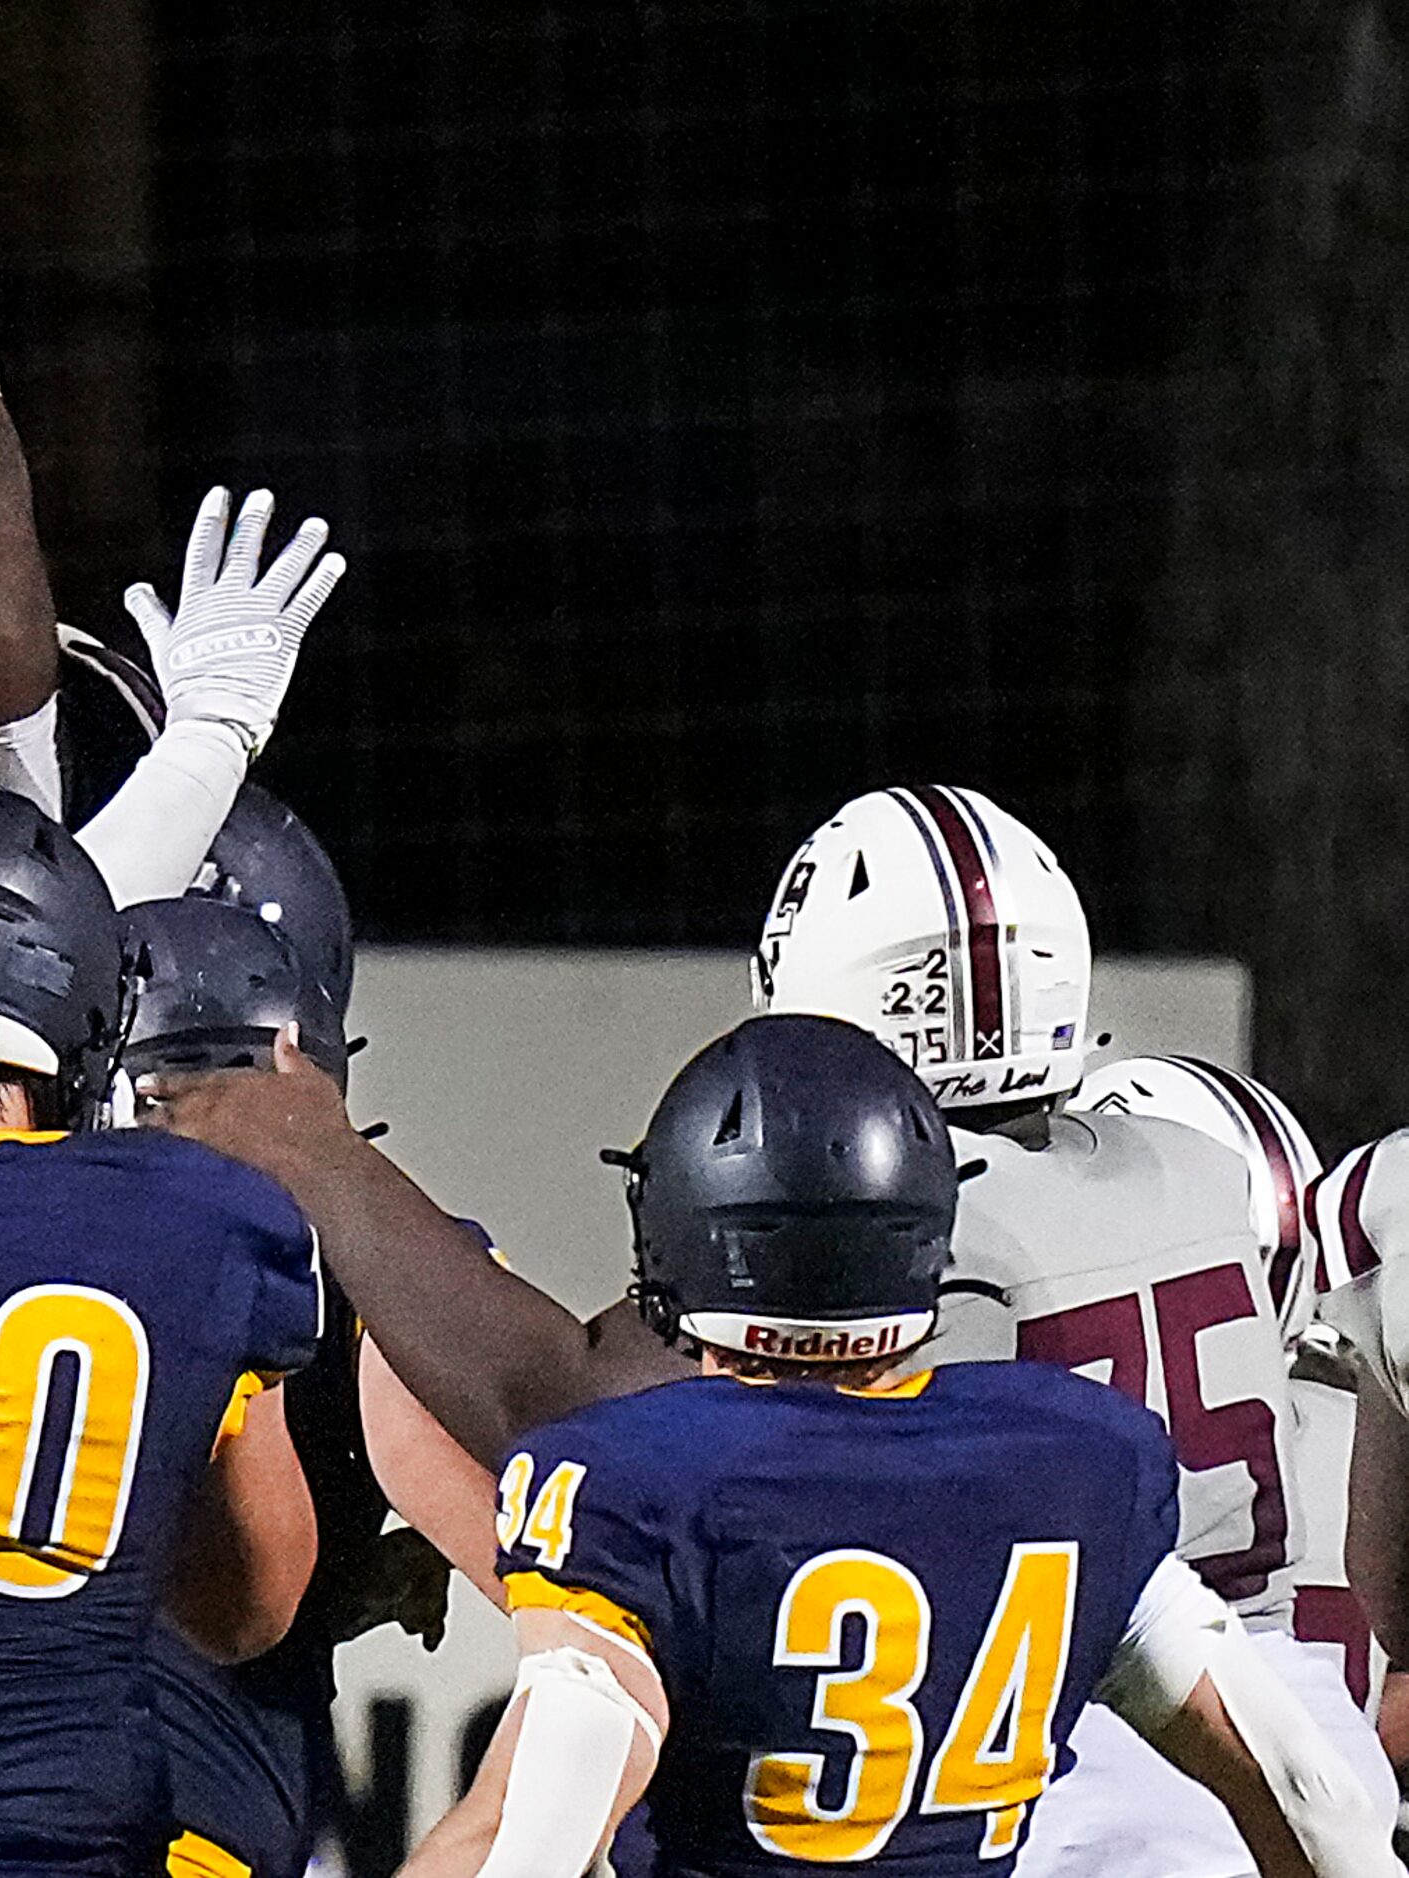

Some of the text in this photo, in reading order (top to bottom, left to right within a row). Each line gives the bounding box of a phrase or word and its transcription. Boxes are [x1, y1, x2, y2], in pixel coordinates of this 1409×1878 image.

[933, 1072, 987, 1100] The
[745, 1324, 902, 1358] Riddell
[495, 1452, 588, 1571] 34
[743, 1541, 1080, 1863] 34
